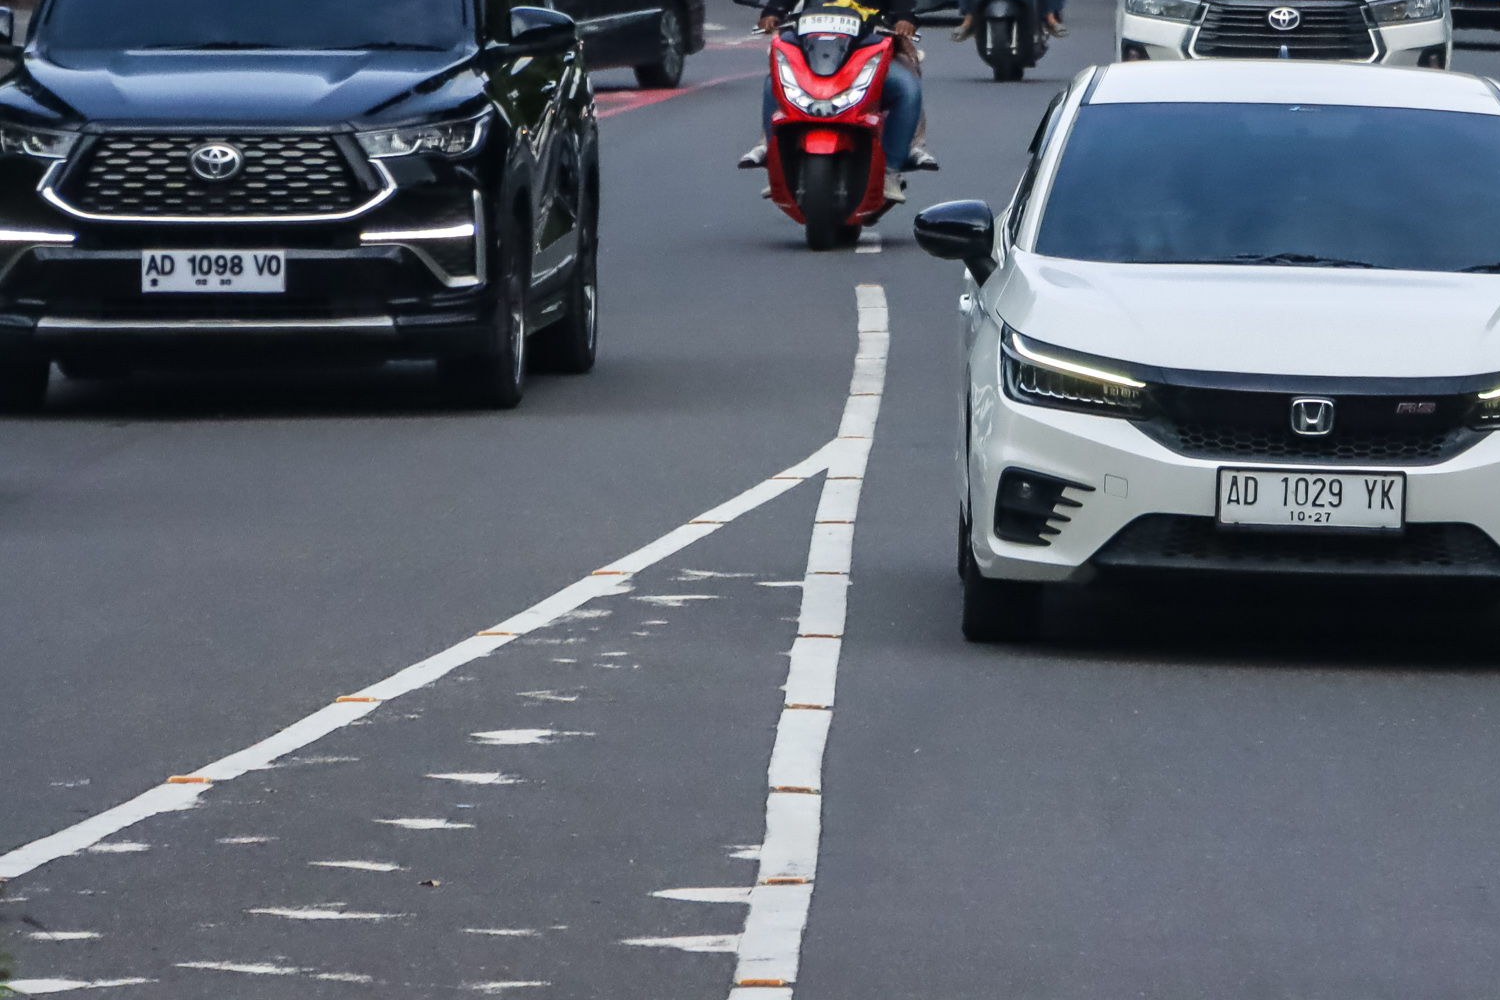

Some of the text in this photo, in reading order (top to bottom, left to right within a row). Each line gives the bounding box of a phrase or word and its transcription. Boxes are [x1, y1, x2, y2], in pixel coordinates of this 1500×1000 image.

[145, 254, 175, 276] AD
[187, 255, 243, 276] 1098
[1227, 476, 1396, 510] AD 1029 YK
